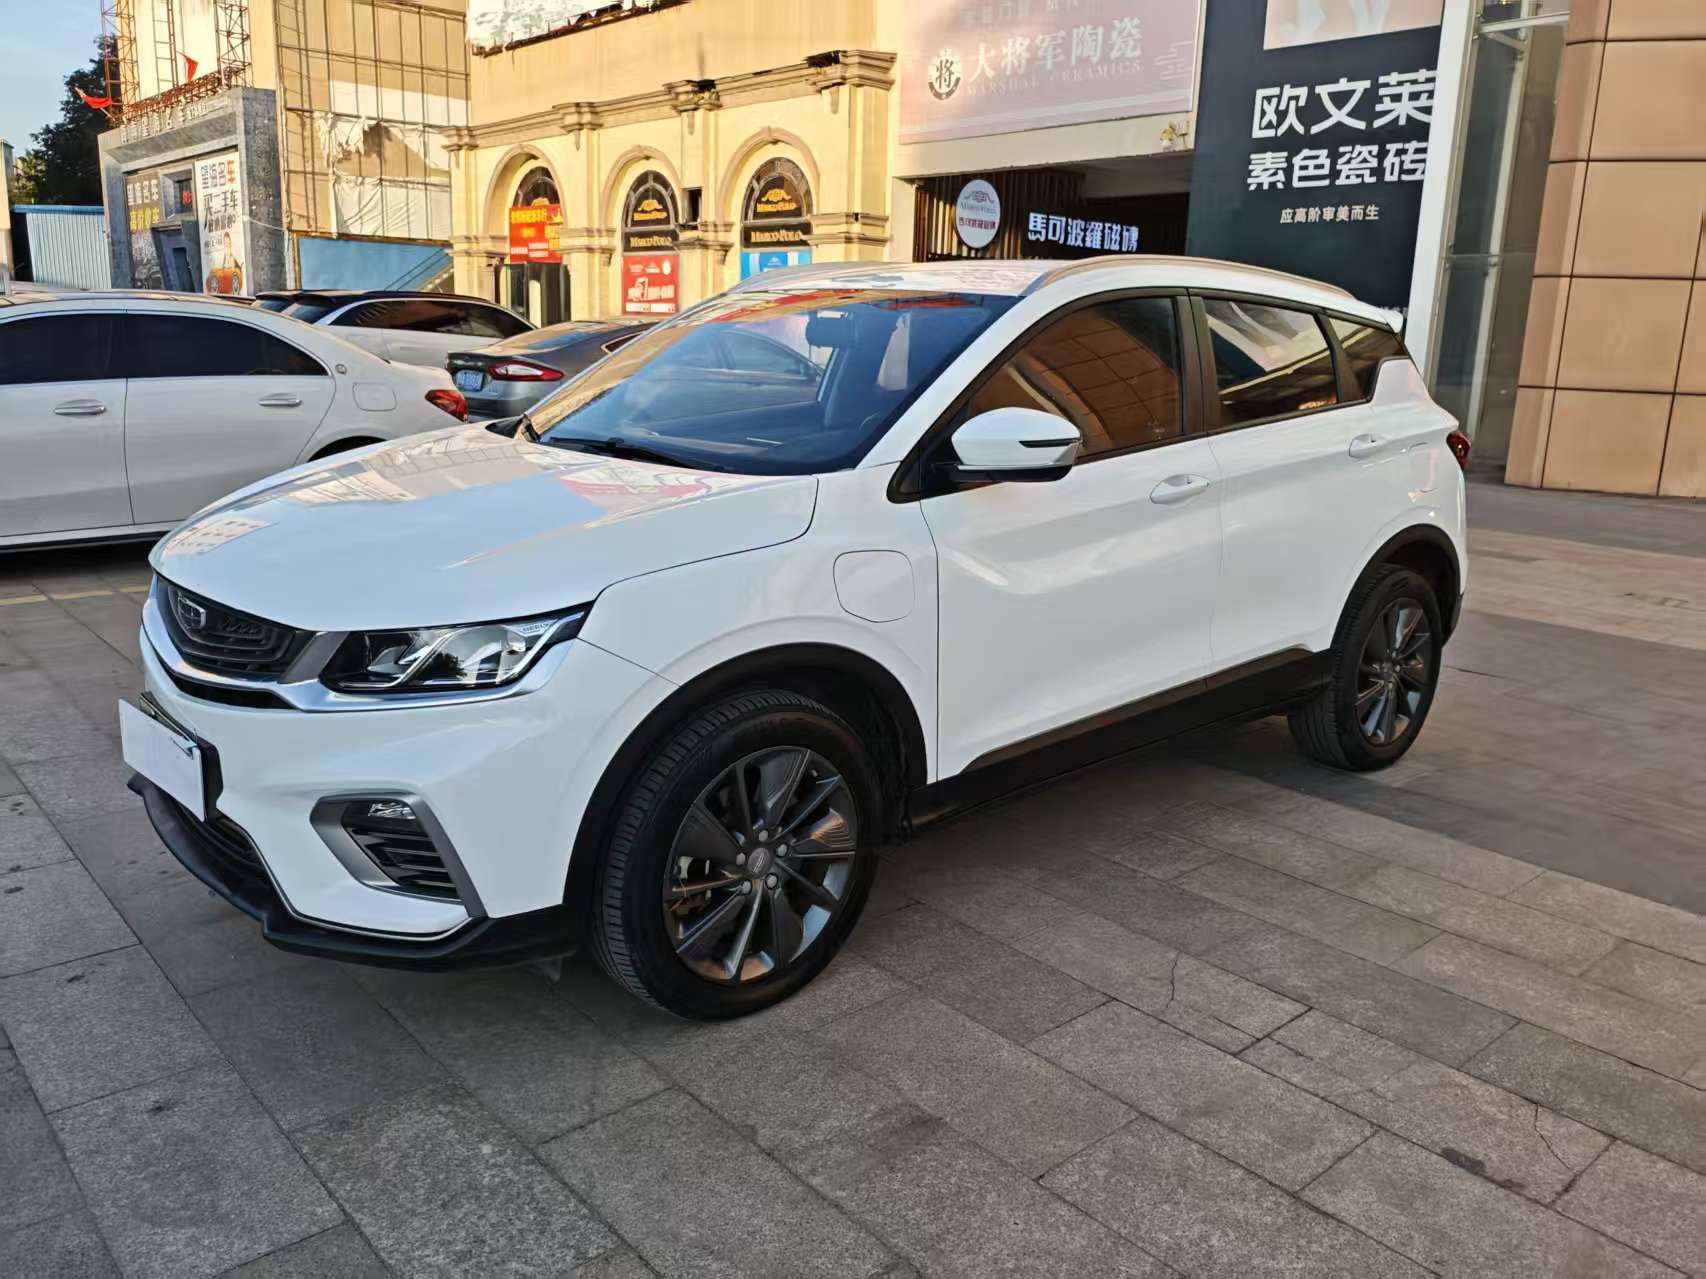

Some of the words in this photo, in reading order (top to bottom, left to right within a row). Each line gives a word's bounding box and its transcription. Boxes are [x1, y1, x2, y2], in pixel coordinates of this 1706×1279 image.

[966, 17, 1142, 84] 大将军陶瓷
[1252, 68, 1436, 139] 欧文莱
[1247, 140, 1429, 191] 素色瓷砖
[1028, 212, 1140, 252] 馬可波羅磁磚
[1280, 204, 1380, 224] 应高阶审美而生
